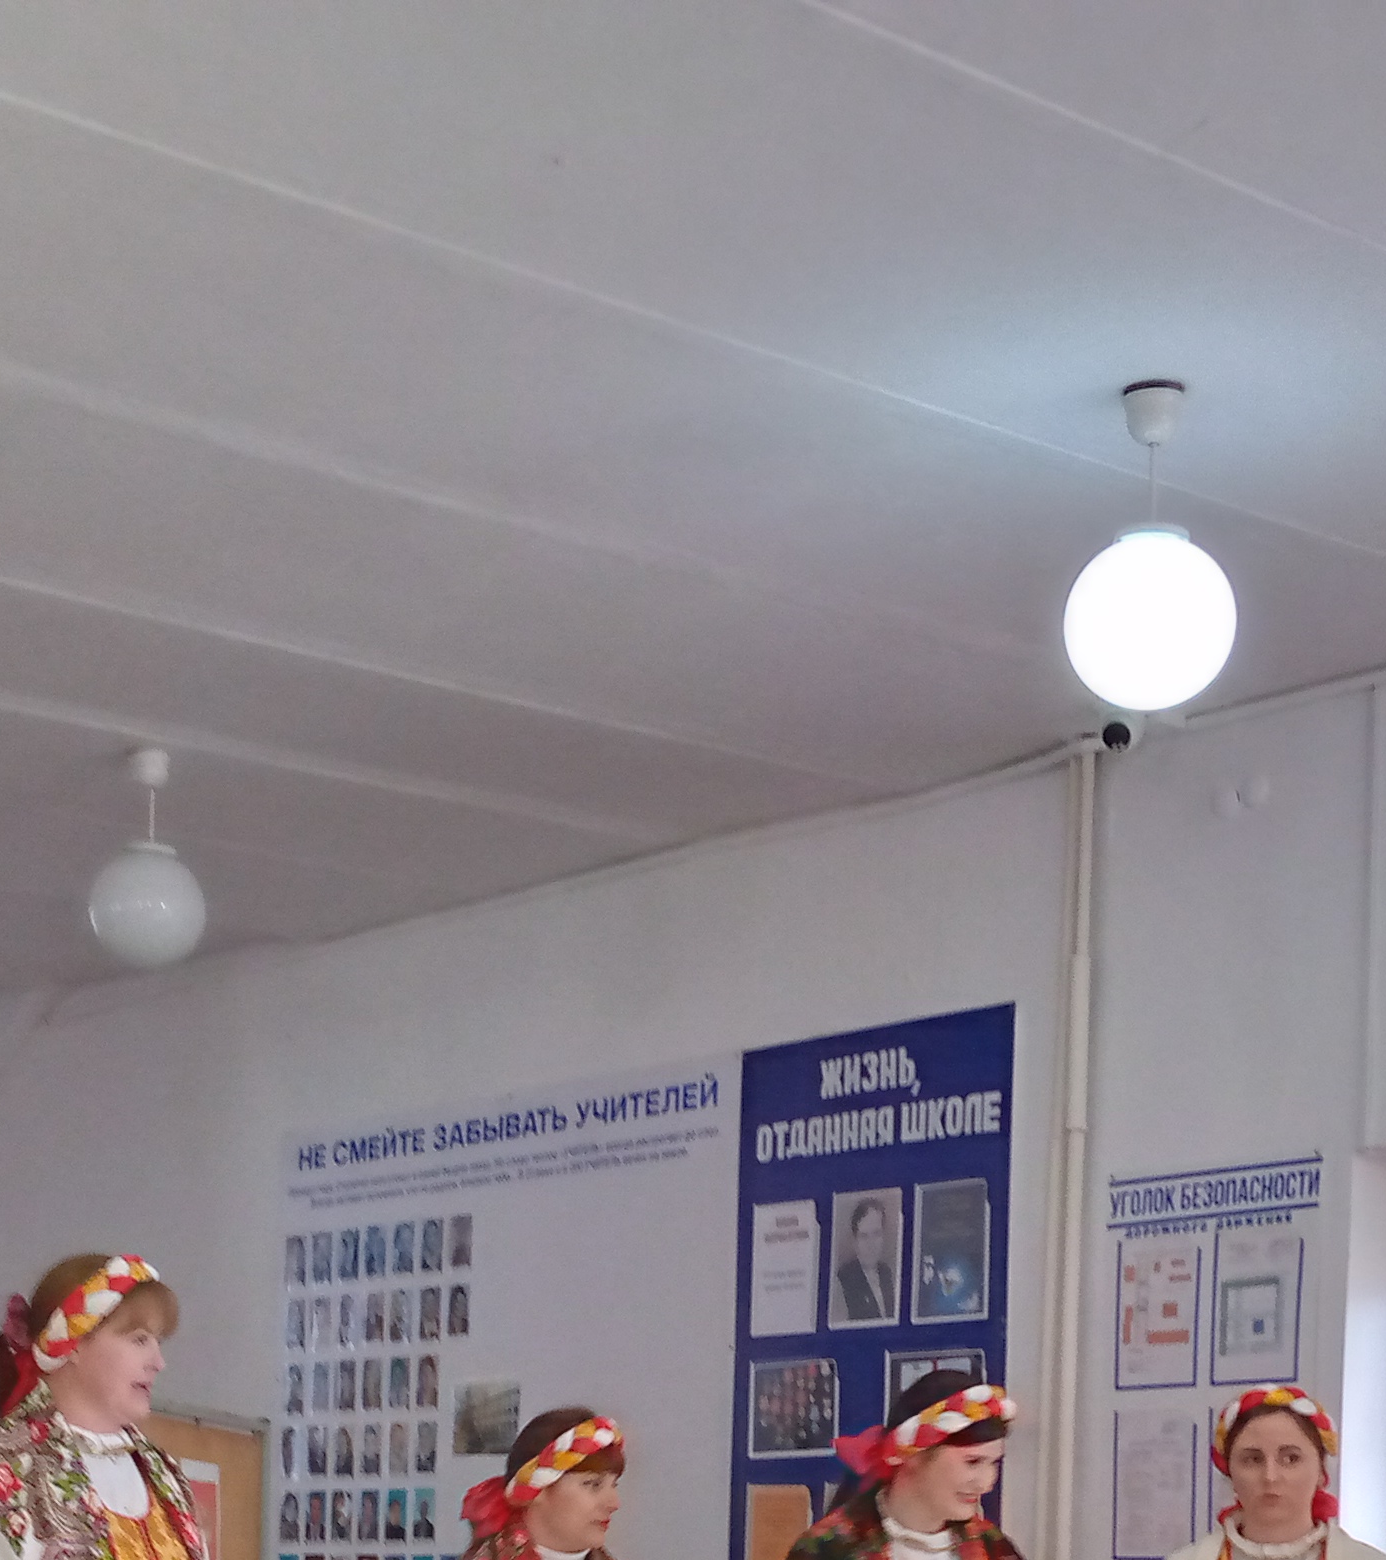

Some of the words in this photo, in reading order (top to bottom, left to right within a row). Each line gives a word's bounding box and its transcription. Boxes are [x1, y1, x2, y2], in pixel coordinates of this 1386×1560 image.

[819, 1046, 921, 1100] ЖИЗНЬ,
[298, 1143, 327, 1171] НЕ
[332, 1125, 426, 1167] СМЕЙТЕ
[433, 1104, 569, 1152] ЗАБЫВАТЬ
[575, 1071, 719, 1130] УЧИТЕЛЕЙ
[756, 1105, 895, 1164] ОТДАННАЯ
[900, 1090, 1002, 1144] ШКОЛЕ
[1110, 1184, 1176, 1219] УГОЛОК
[1180, 1167, 1321, 1211] БЕЗОПАСНОСТИ
